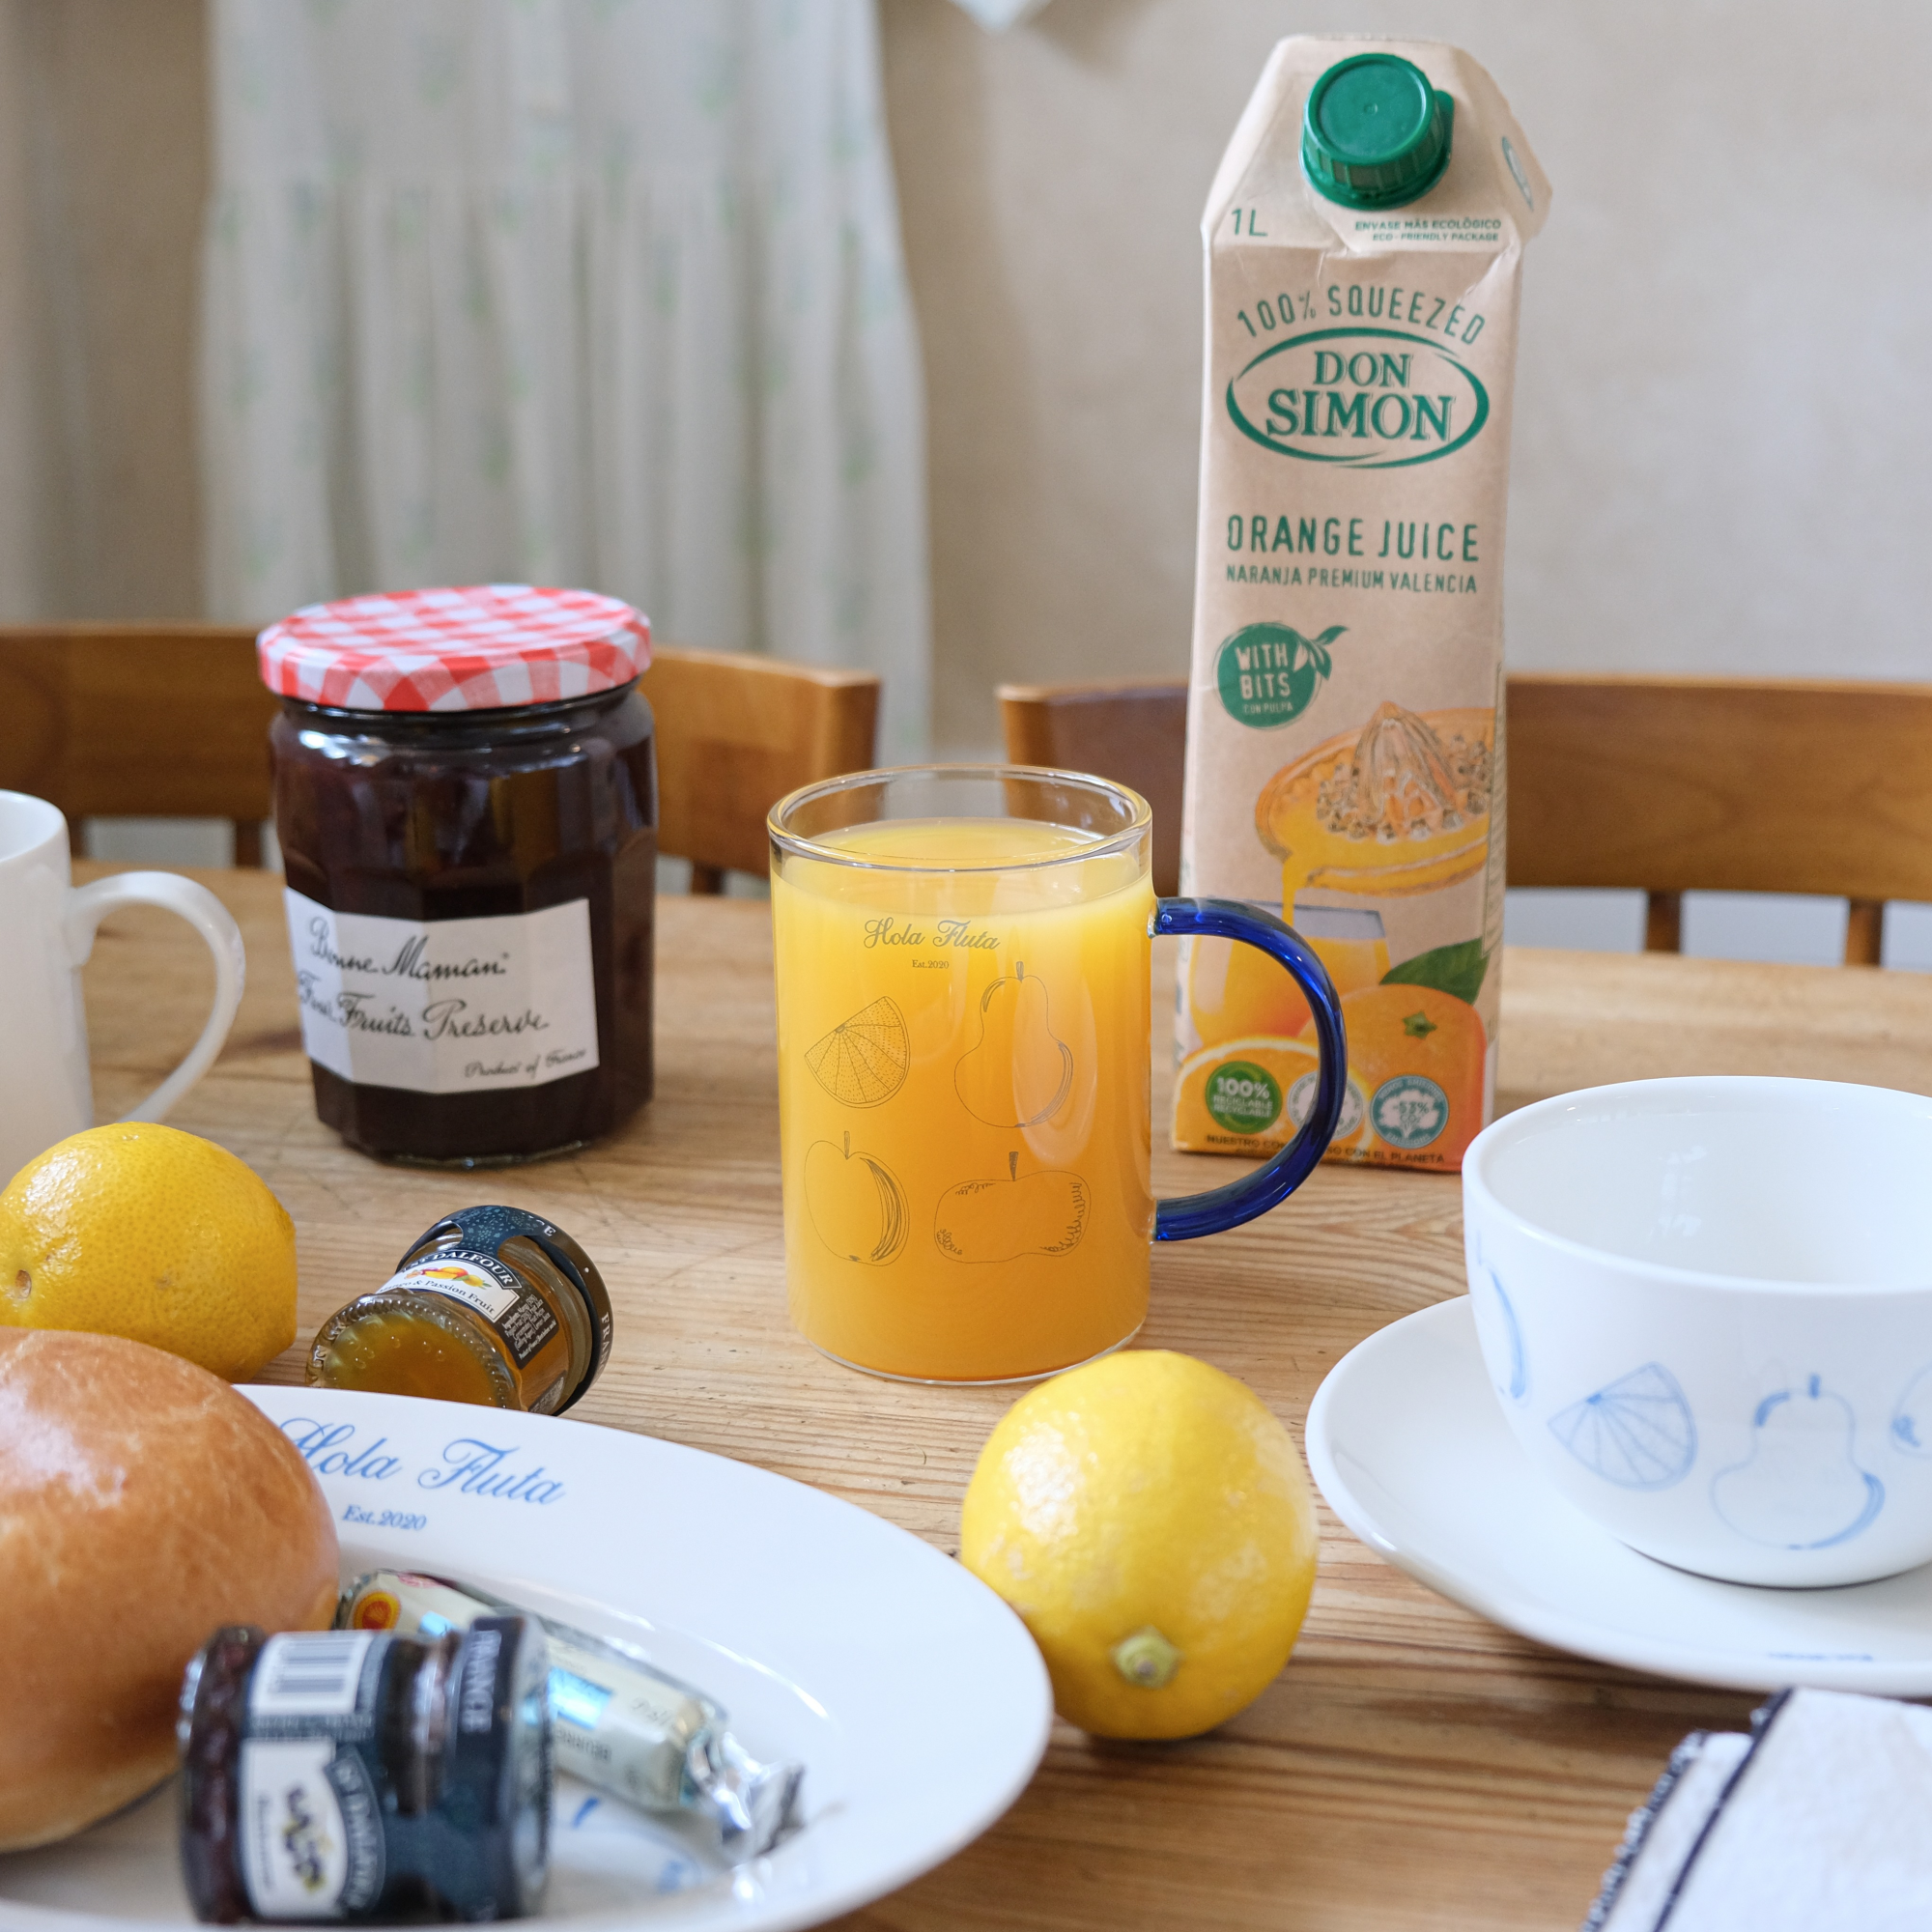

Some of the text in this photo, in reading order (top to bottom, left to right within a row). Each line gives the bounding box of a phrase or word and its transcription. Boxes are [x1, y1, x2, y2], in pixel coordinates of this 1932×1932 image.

[1232, 208, 1268, 238] 1L
[1355, 216, 1502, 231] ENVASE MÁS ECOLÓGICO
[1451, 233, 1498, 242] PACKAGE
[1237, 285, 1486, 345] 100% SQUEEZED
[1313, 351, 1412, 388] DON
[1265, 388, 1456, 442] SIMON
[1227, 514, 1479, 562] ORANGE JUICE
[1226, 564, 1478, 593] NARANJA PREMIUM VALENCIA
[1236, 642, 1289, 671] WITH
[1240, 671, 1291, 699] BITS
[1244, 701, 1293, 714] CON PULPA
[864, 917, 1001, 950] Hola Fluta
[912, 959, 950, 969] Est.2020
[336, 991, 415, 1037] Fruits
[422, 998, 550, 1040] Preserve
[525, 1054, 542, 1079] of
[1217, 1076, 1270, 1099] 100%
[1207, 1135, 1260, 1149] NUESTRO
[1392, 1152, 1445, 1163] PLANETA
[434, 1250, 515, 1285] DALFOUR
[424, 1280, 468, 1296] Passion
[468, 1293, 496, 1314] Fruit
[417, 1438, 566, 1505] Fluta
[342, 1504, 428, 1531] Est.2020
